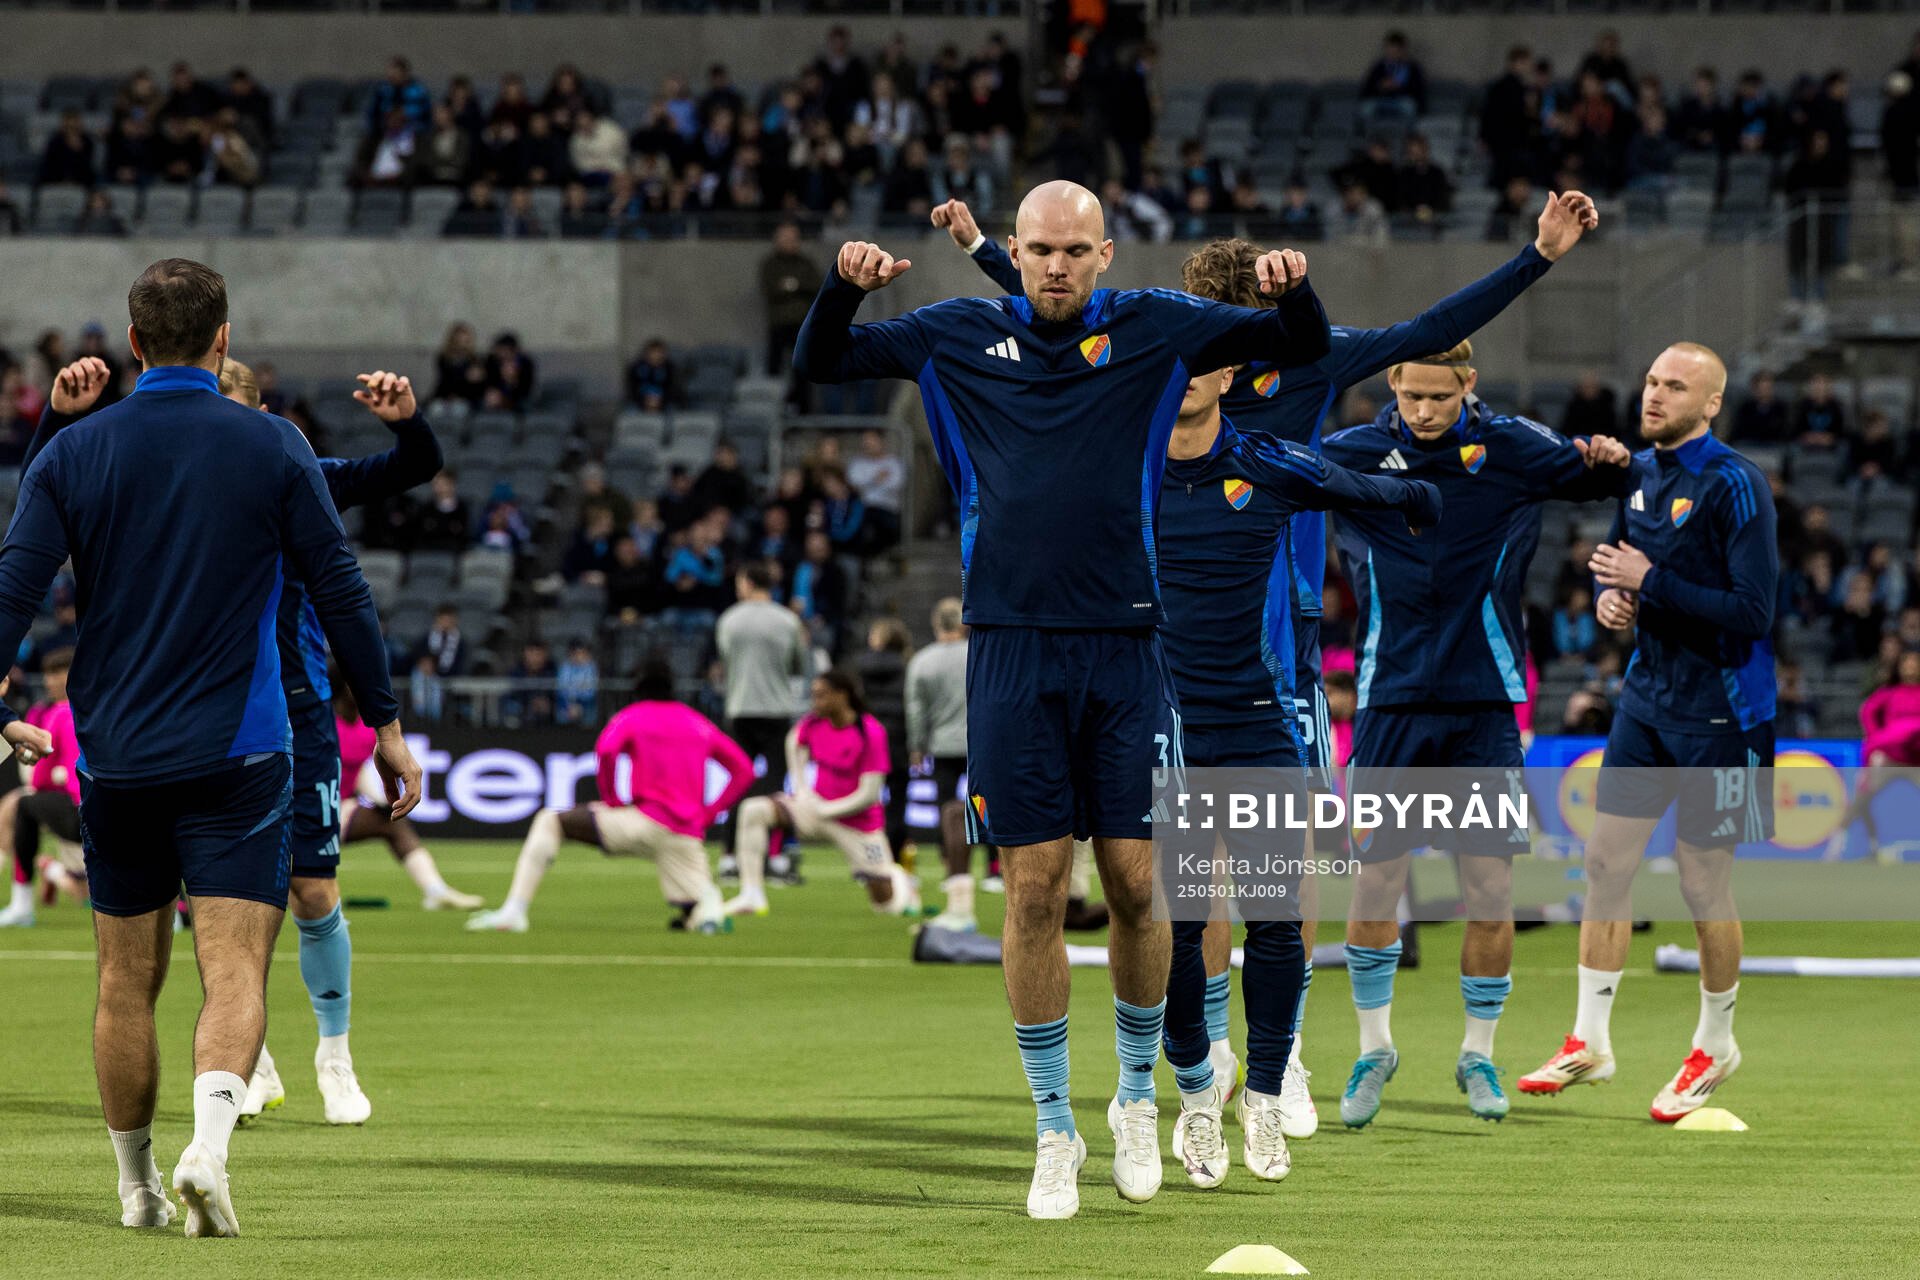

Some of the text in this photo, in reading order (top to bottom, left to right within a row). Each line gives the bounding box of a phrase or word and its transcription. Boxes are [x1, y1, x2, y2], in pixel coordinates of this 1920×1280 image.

[1152, 734, 1169, 787] 3
[315, 779, 341, 827] 14
[1712, 766, 1746, 812] 18
